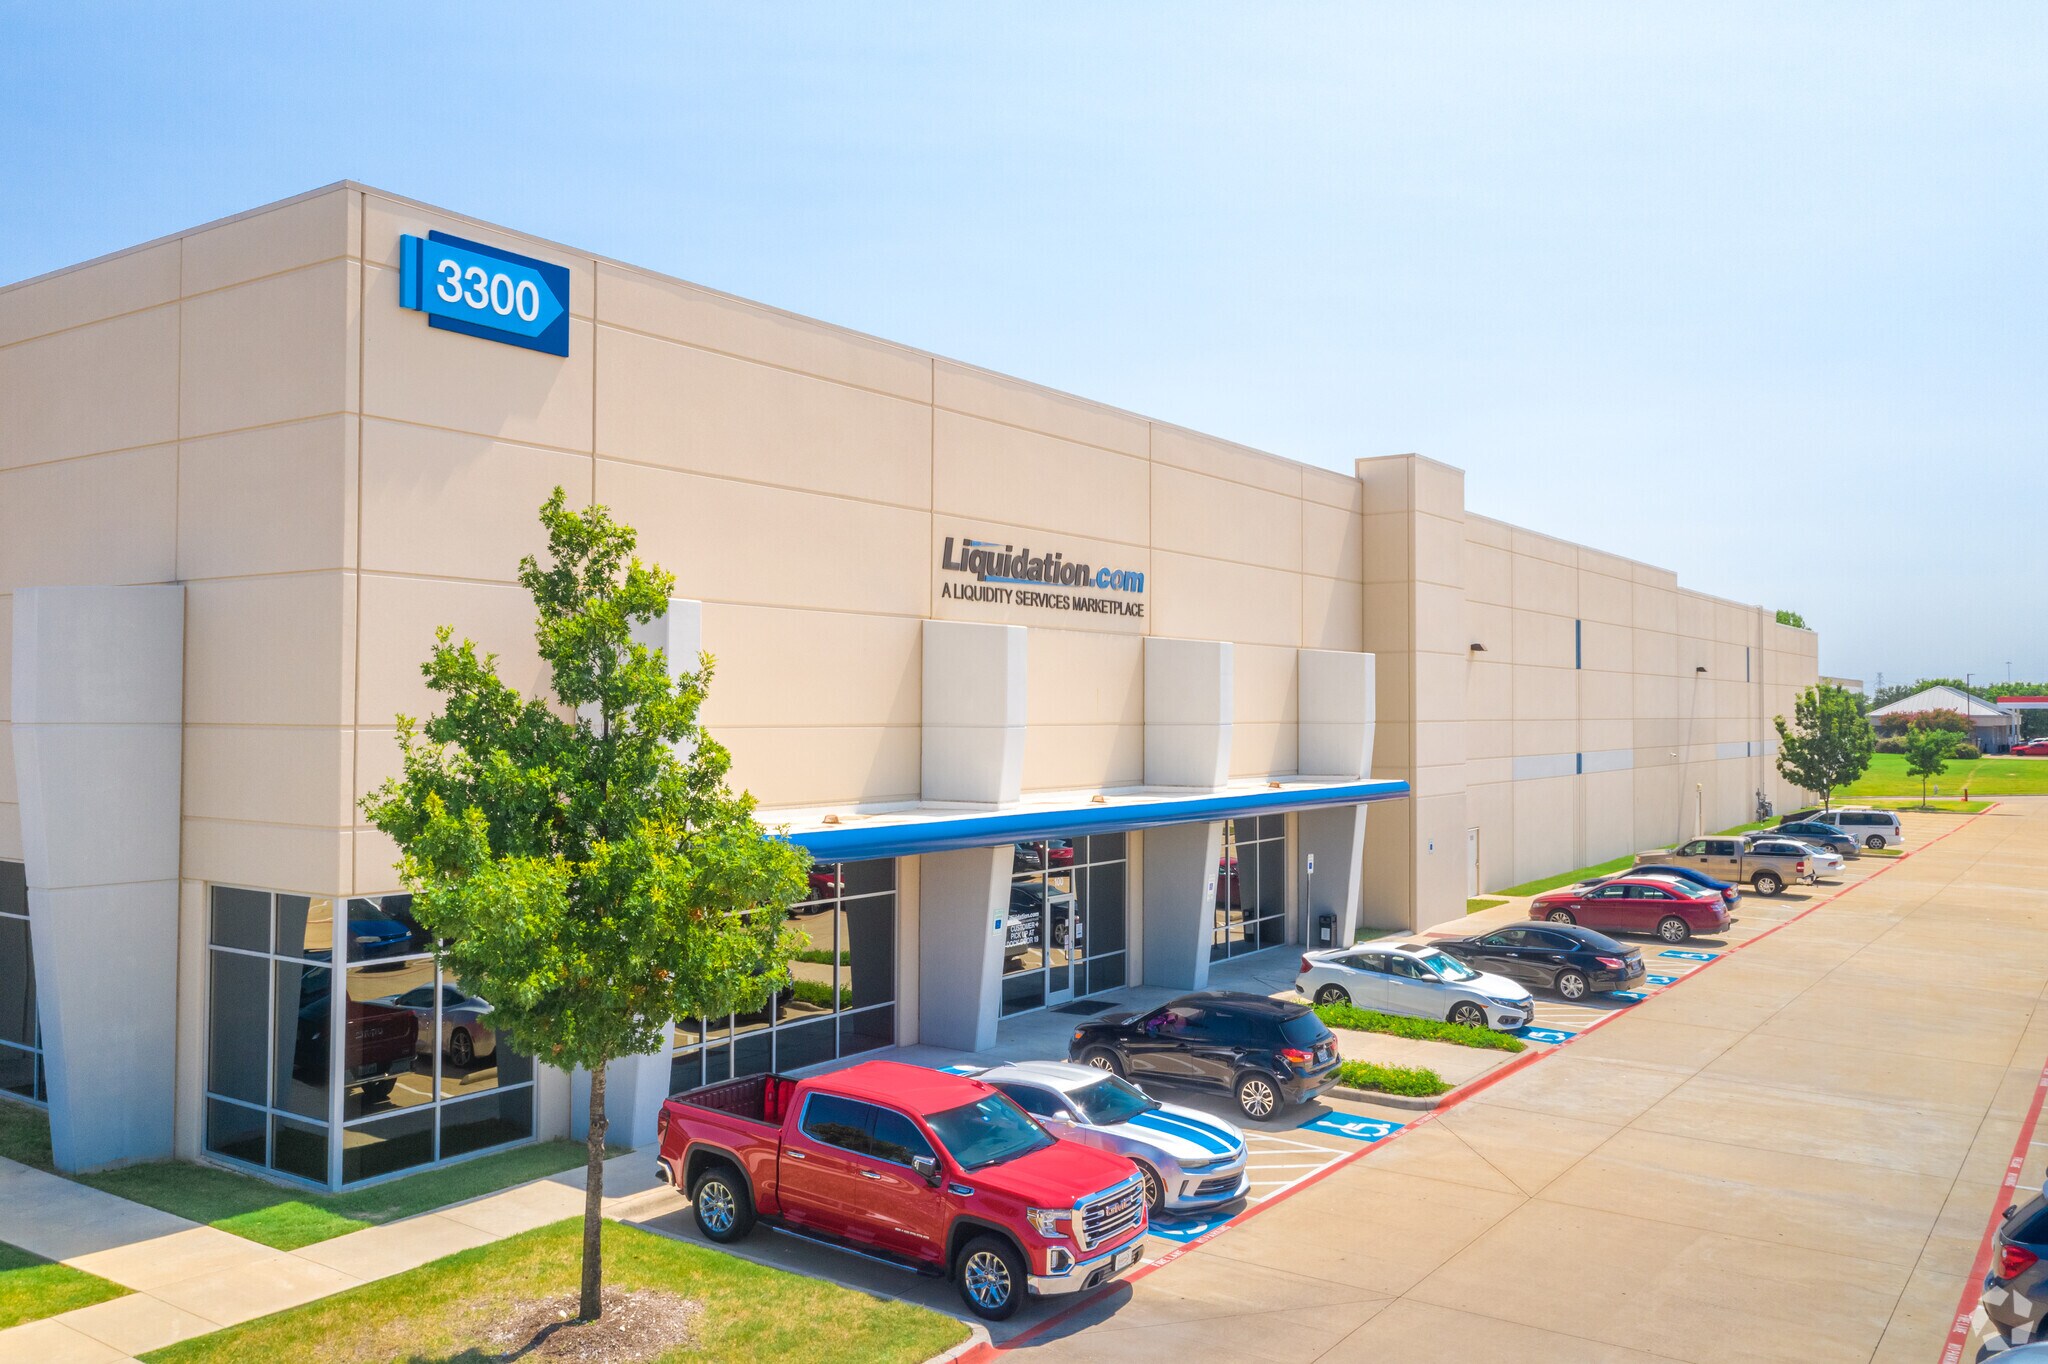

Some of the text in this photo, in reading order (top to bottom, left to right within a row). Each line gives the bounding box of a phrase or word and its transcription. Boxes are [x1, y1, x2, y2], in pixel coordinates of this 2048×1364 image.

[437, 259, 540, 322] 3300
[942, 537, 1144, 593] Liquidation.com
[941, 582, 1144, 617] A LIQUIDITY SERVICES MARKETPLACE
[1054, 877, 1063, 886] 100
[1105, 1197, 1132, 1217] GMC
